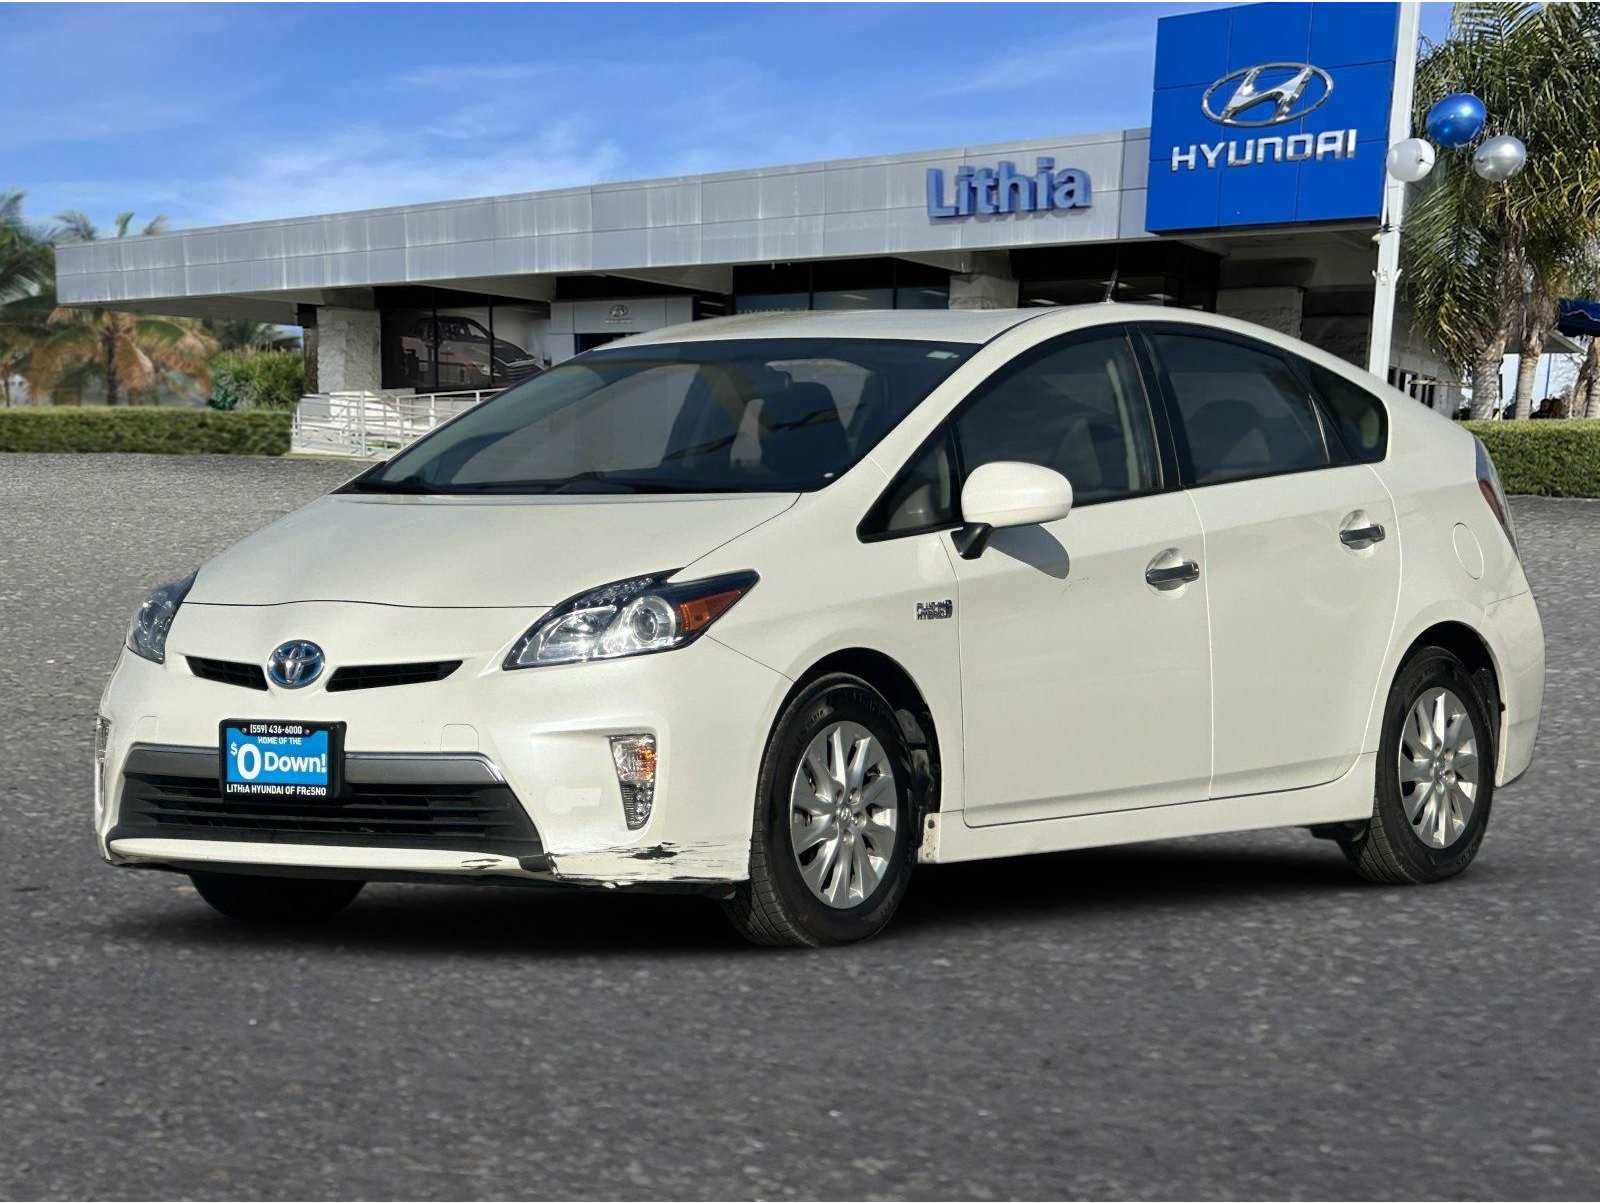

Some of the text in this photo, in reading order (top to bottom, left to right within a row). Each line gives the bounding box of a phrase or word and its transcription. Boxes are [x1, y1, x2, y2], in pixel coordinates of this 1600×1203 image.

[1171, 129, 1357, 171] HYUNDAI
[926, 157, 1092, 217] Lithia
[250, 724, 302, 734] (559) 436-6000
[258, 736, 277, 744] HOME
[289, 737, 302, 745] THE
[264, 752, 327, 773] Down!
[251, 784, 283, 794] HYUNDAI
[285, 786, 295, 794] OF
